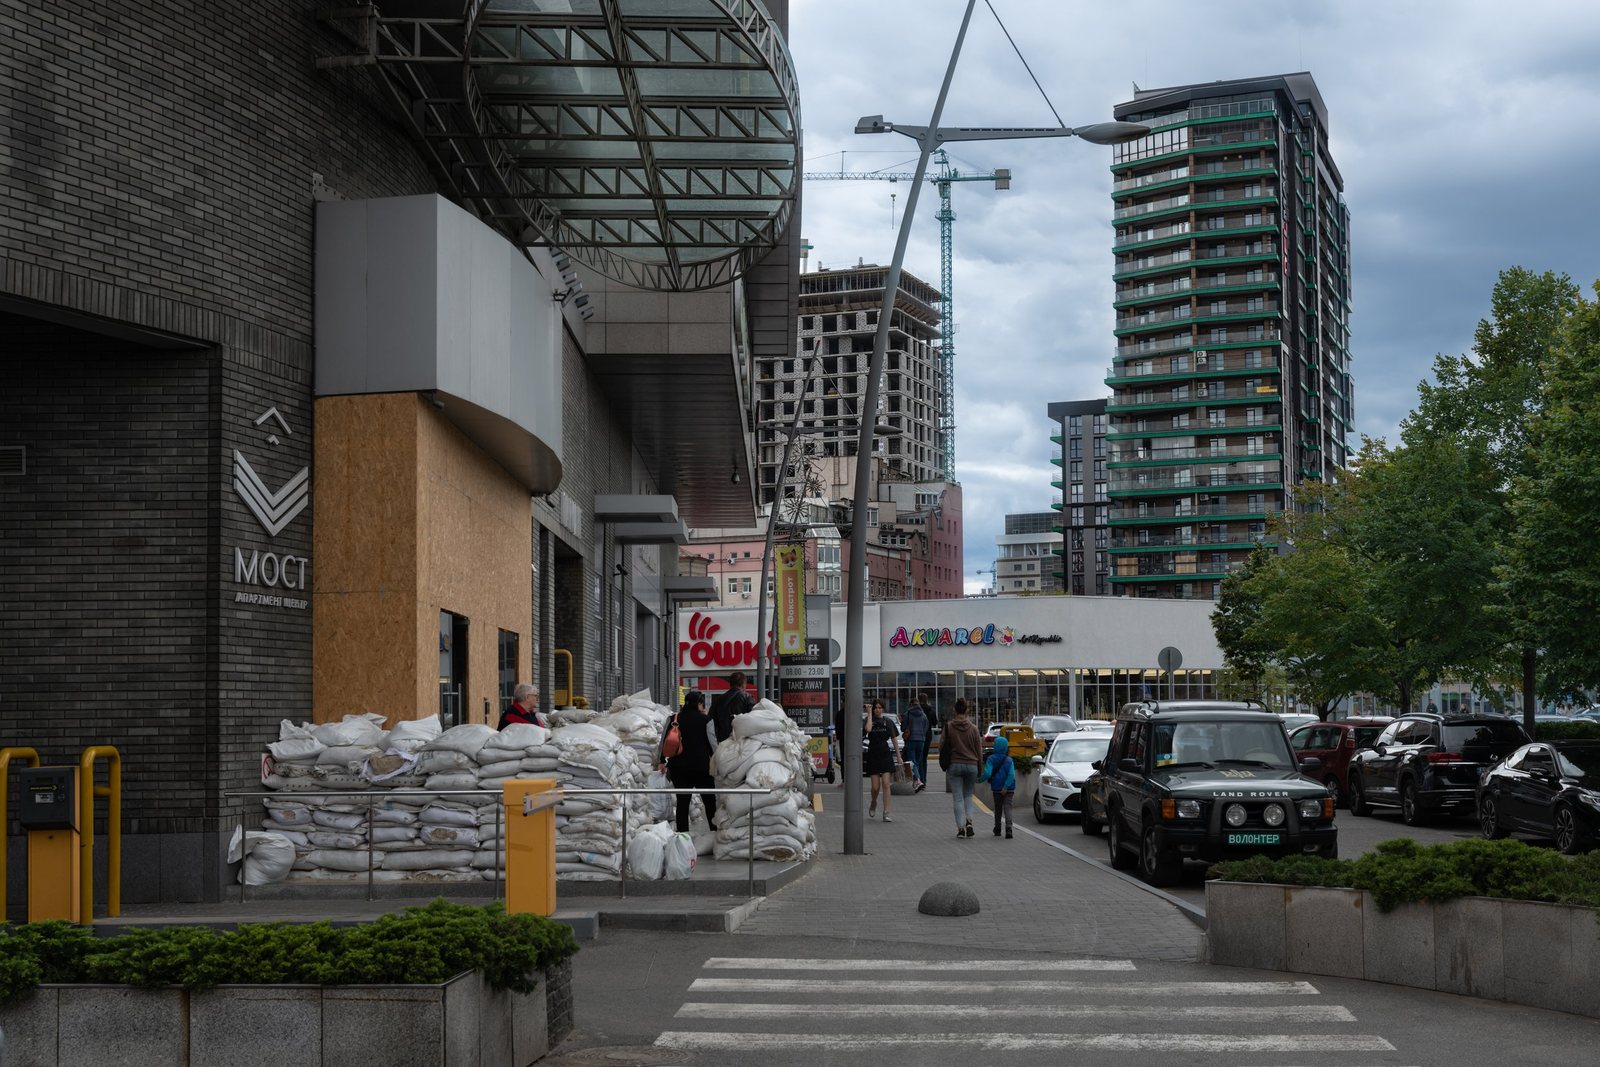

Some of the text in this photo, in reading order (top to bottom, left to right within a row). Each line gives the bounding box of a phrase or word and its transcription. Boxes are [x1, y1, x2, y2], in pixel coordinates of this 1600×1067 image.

[234, 547, 308, 590] МОСТ
[788, 681, 823, 690] TAKE AWAY
[1228, 833, 1280, 844] ВОЛОНТЕР
